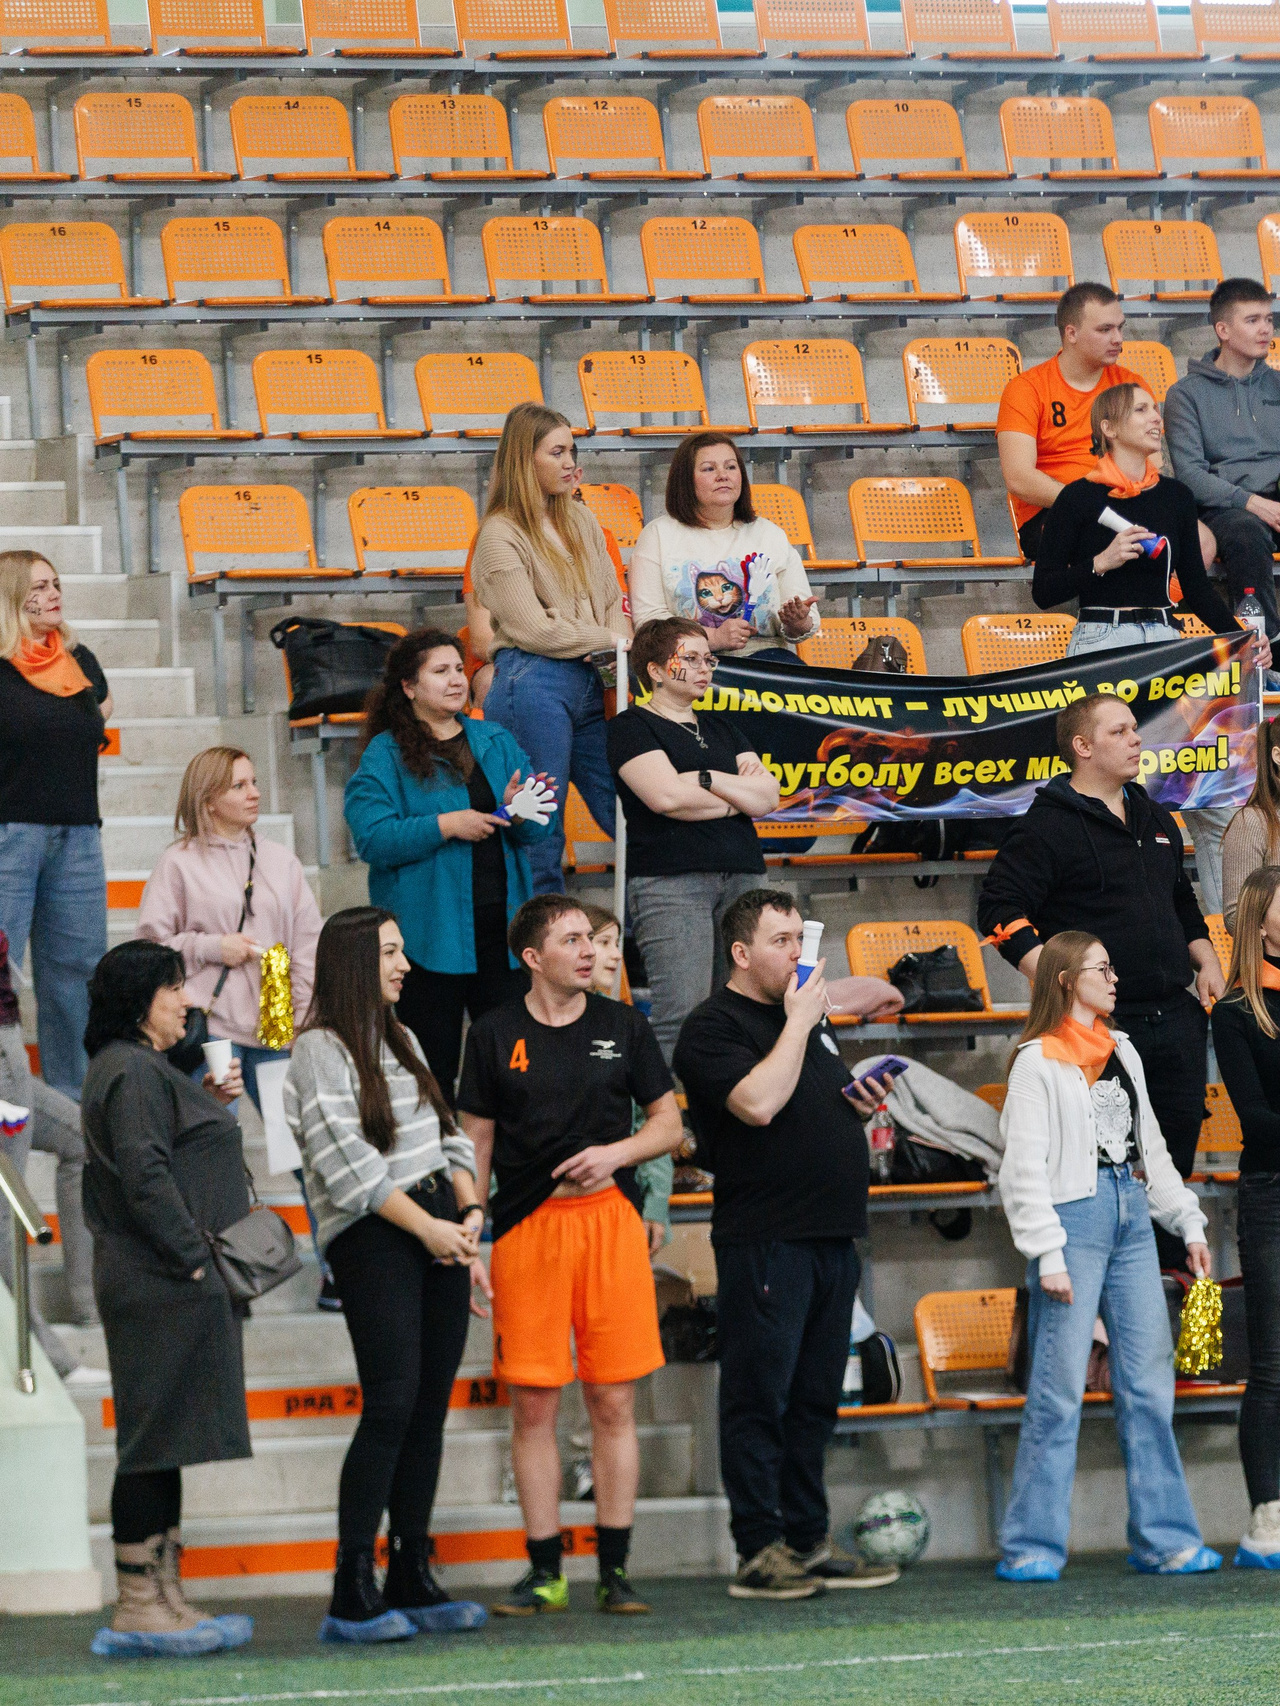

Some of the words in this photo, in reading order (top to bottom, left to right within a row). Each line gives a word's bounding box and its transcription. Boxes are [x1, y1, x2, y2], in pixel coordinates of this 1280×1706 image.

[126, 97, 142, 108] 15
[284, 100, 299, 110] 14
[440, 99, 456, 110] 13
[593, 100, 608, 110] 12
[747, 98, 761, 108] 11
[894, 103, 909, 112] 10
[1200, 100, 1207, 110] 8
[214, 221, 230, 231] 15
[374, 221, 391, 231] 14
[533, 220, 549, 231] 13
[691, 220, 707, 230] 12
[1004, 216, 1019, 226] 10
[50, 226, 66, 236] 16
[842, 228, 857, 238] 11
[1153, 224, 1161, 234] 9
[793, 343, 810, 354] 12
[954, 341, 970, 351] 11
[1270, 340, 1277, 350] 9
[141, 354, 158, 365] 16
[306, 353, 323, 364] 15
[467, 356, 484, 366] 14
[629, 354, 646, 365] 13
[1051, 401, 1067, 428] 8
[234, 490, 251, 501] 16
[402, 490, 420, 501] 15
[849, 621, 867, 632] 13
[1015, 618, 1032, 629] 12
[635, 677, 894, 719] алдоломит
[942, 680, 1087, 724] лучший
[1148, 662, 1241, 701] всем!
[934, 758, 1017, 786] всех
[1136, 736, 1230, 785] рвем!
[903, 925, 921, 936] 14
[509, 1038, 530, 1073] 4
